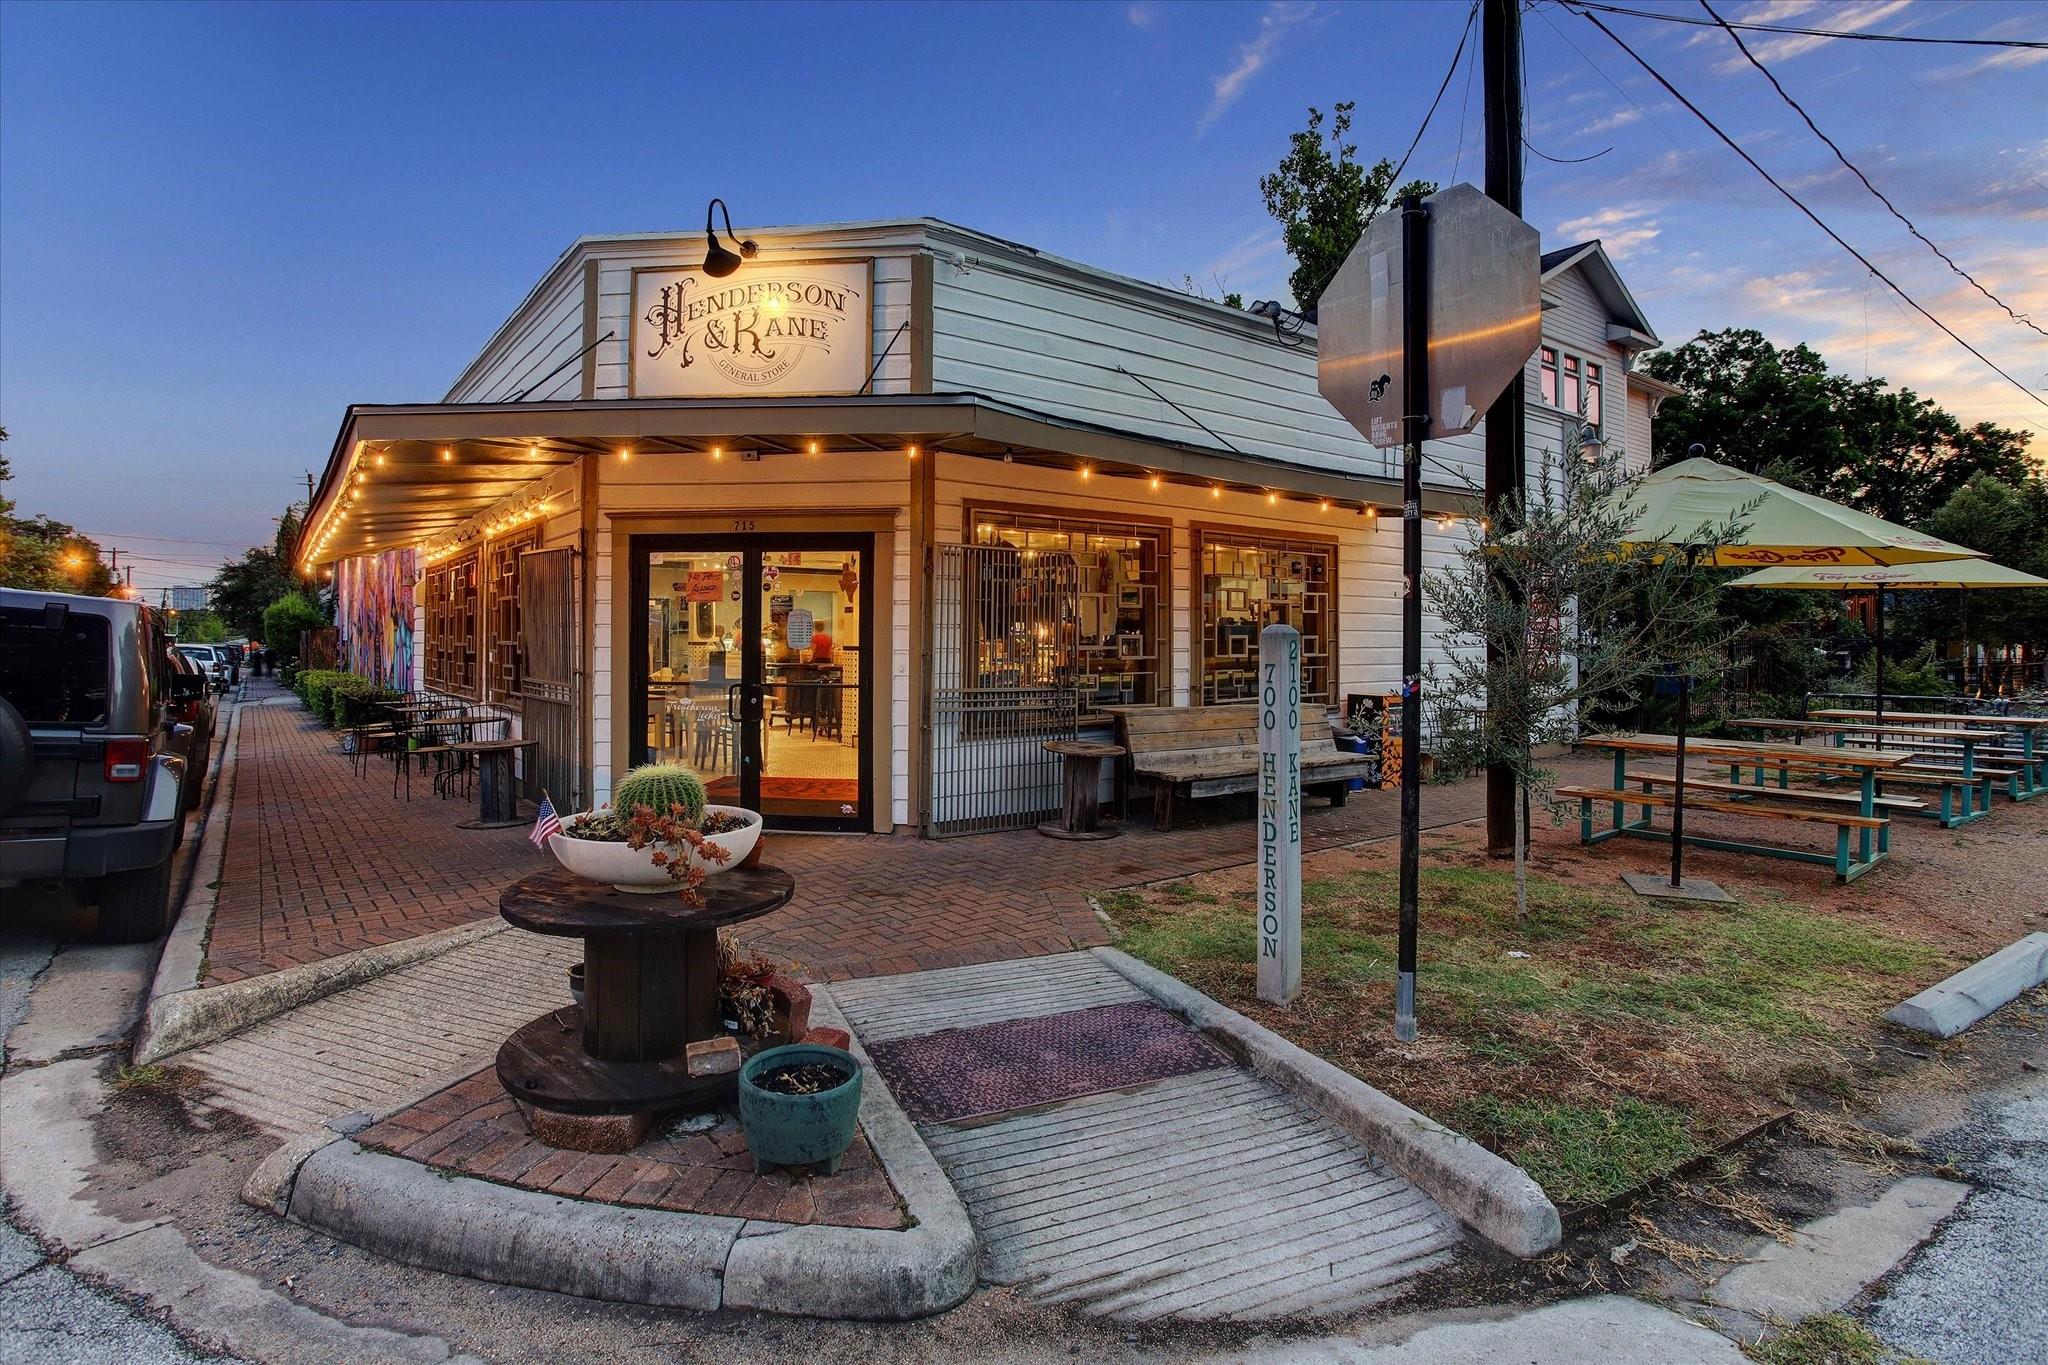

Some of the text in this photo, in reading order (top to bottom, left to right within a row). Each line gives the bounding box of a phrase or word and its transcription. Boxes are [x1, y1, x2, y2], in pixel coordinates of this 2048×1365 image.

[645, 277, 848, 362] HENDERSON
[704, 305, 830, 360] & KANE
[719, 359, 790, 381] GENERAL STORE
[734, 520, 755, 531] 715
[1264, 664, 1276, 731] 700
[1289, 639, 1297, 731] 2100
[1288, 752, 1299, 843] KANE
[1262, 752, 1278, 959] HENDERSON
